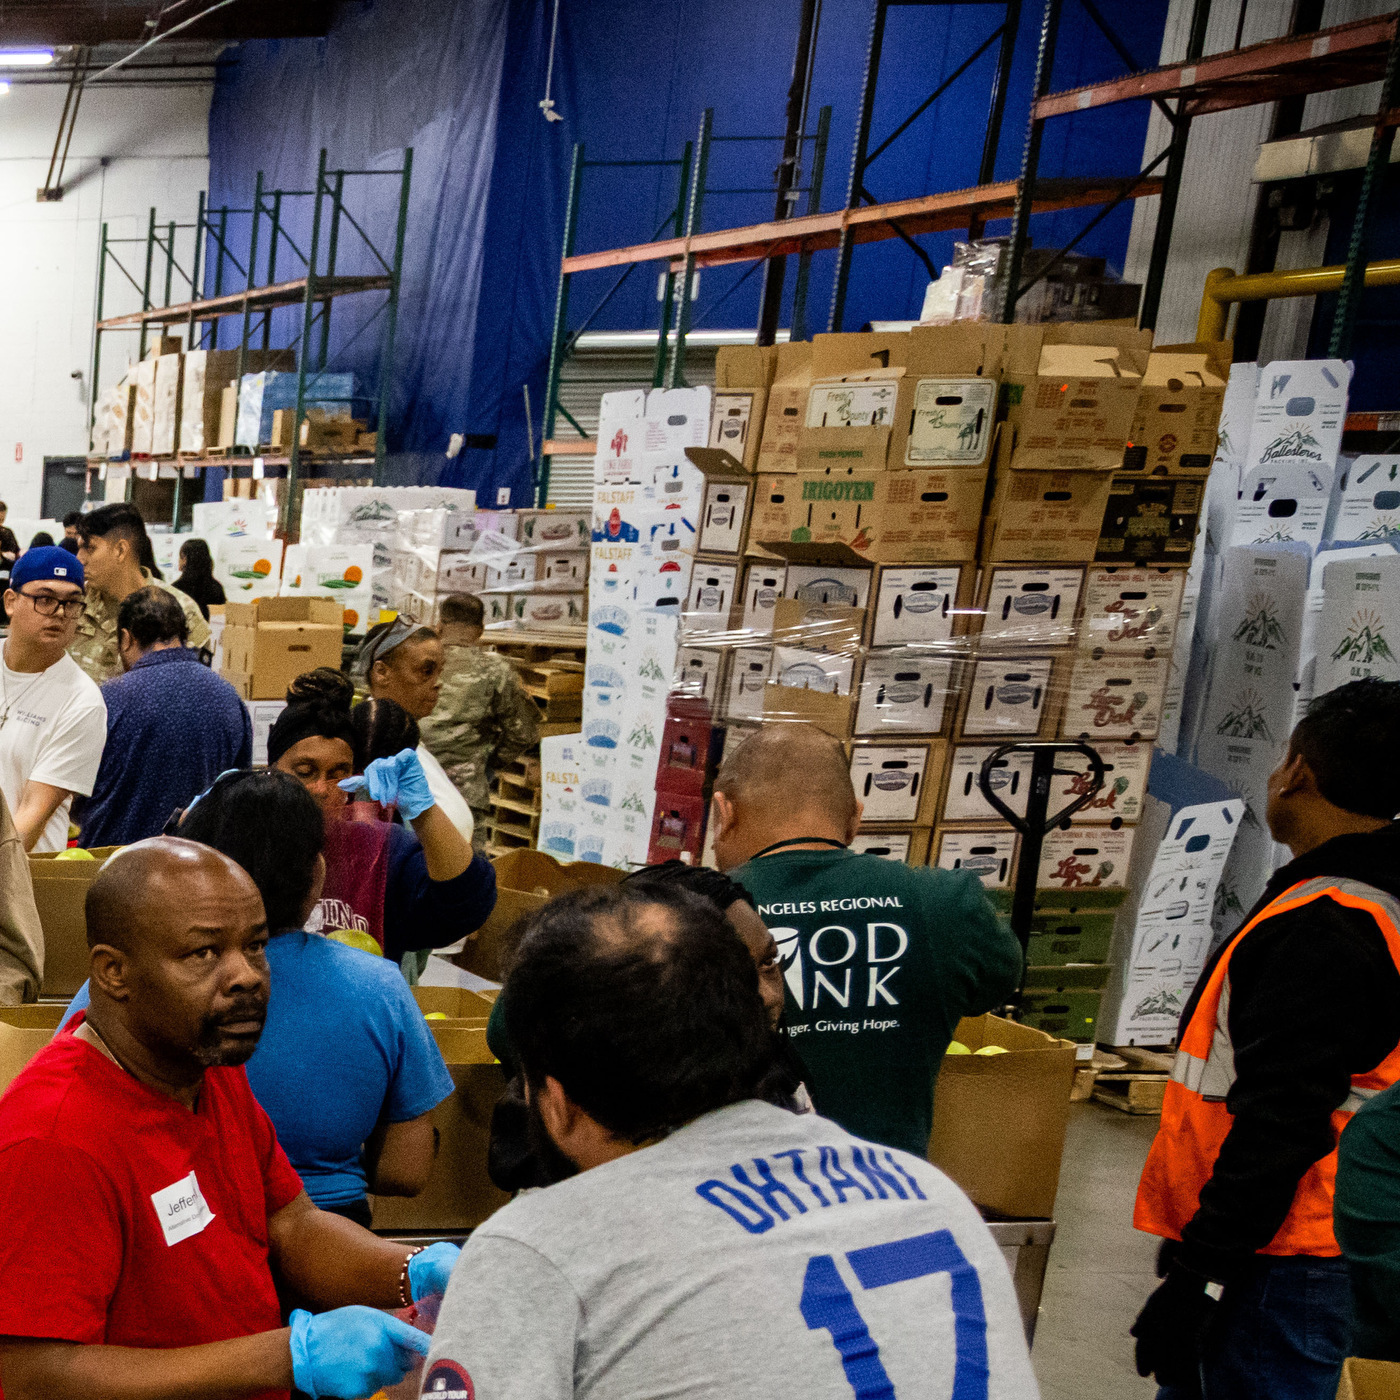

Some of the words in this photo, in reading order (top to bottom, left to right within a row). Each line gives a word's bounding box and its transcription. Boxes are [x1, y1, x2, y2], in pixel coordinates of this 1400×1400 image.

[827, 391, 848, 403] Fresh
[917, 409, 940, 418] Fresh
[1259, 443, 1323, 464] Ballesteros
[597, 488, 636, 504] FALSTAFF
[802, 480, 876, 502] IRIGOYEN
[594, 547, 633, 563] FALSTAFF
[546, 771, 580, 785] FALSTA
[820, 896, 904, 912] REGIONAL
[815, 1020, 860, 1035] Giving
[863, 1018, 901, 1032] Hope.
[696, 1146, 928, 1235] OHTANI
